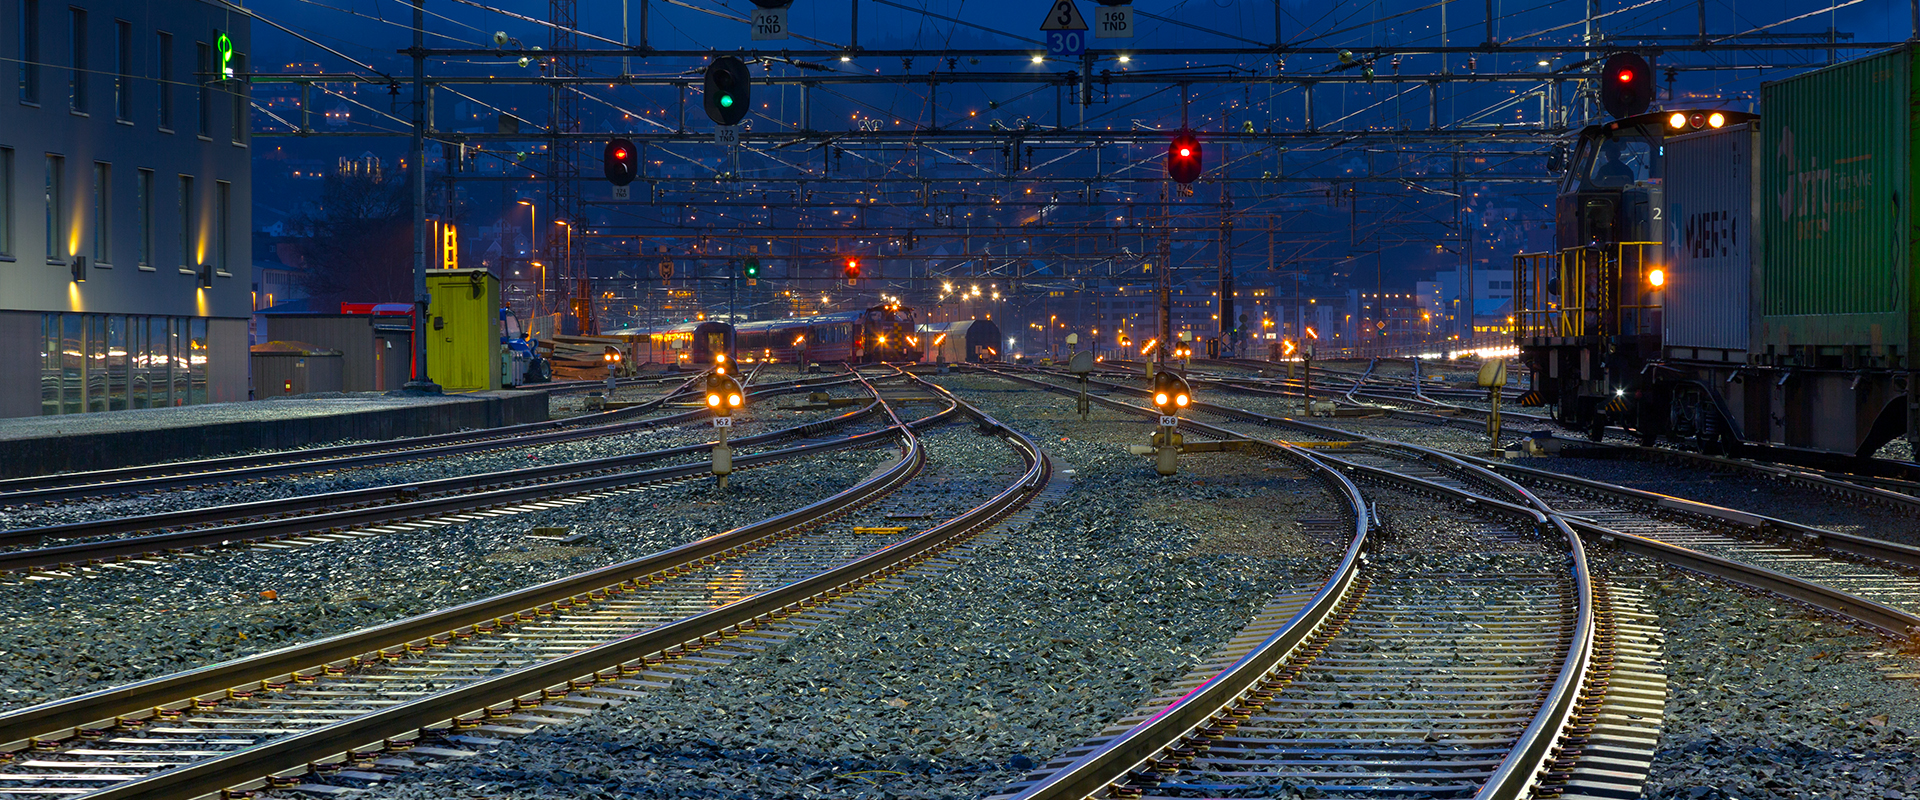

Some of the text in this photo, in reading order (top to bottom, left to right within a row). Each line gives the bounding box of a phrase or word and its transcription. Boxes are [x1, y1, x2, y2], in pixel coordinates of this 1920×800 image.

[1057, 1, 1072, 26] 3
[1104, 12, 1125, 21] 160
[760, 15, 779, 24] 162
[758, 24, 781, 34] TND
[1102, 22, 1127, 31] TND
[1051, 32, 1080, 52] 30
[716, 418, 730, 426] 162
